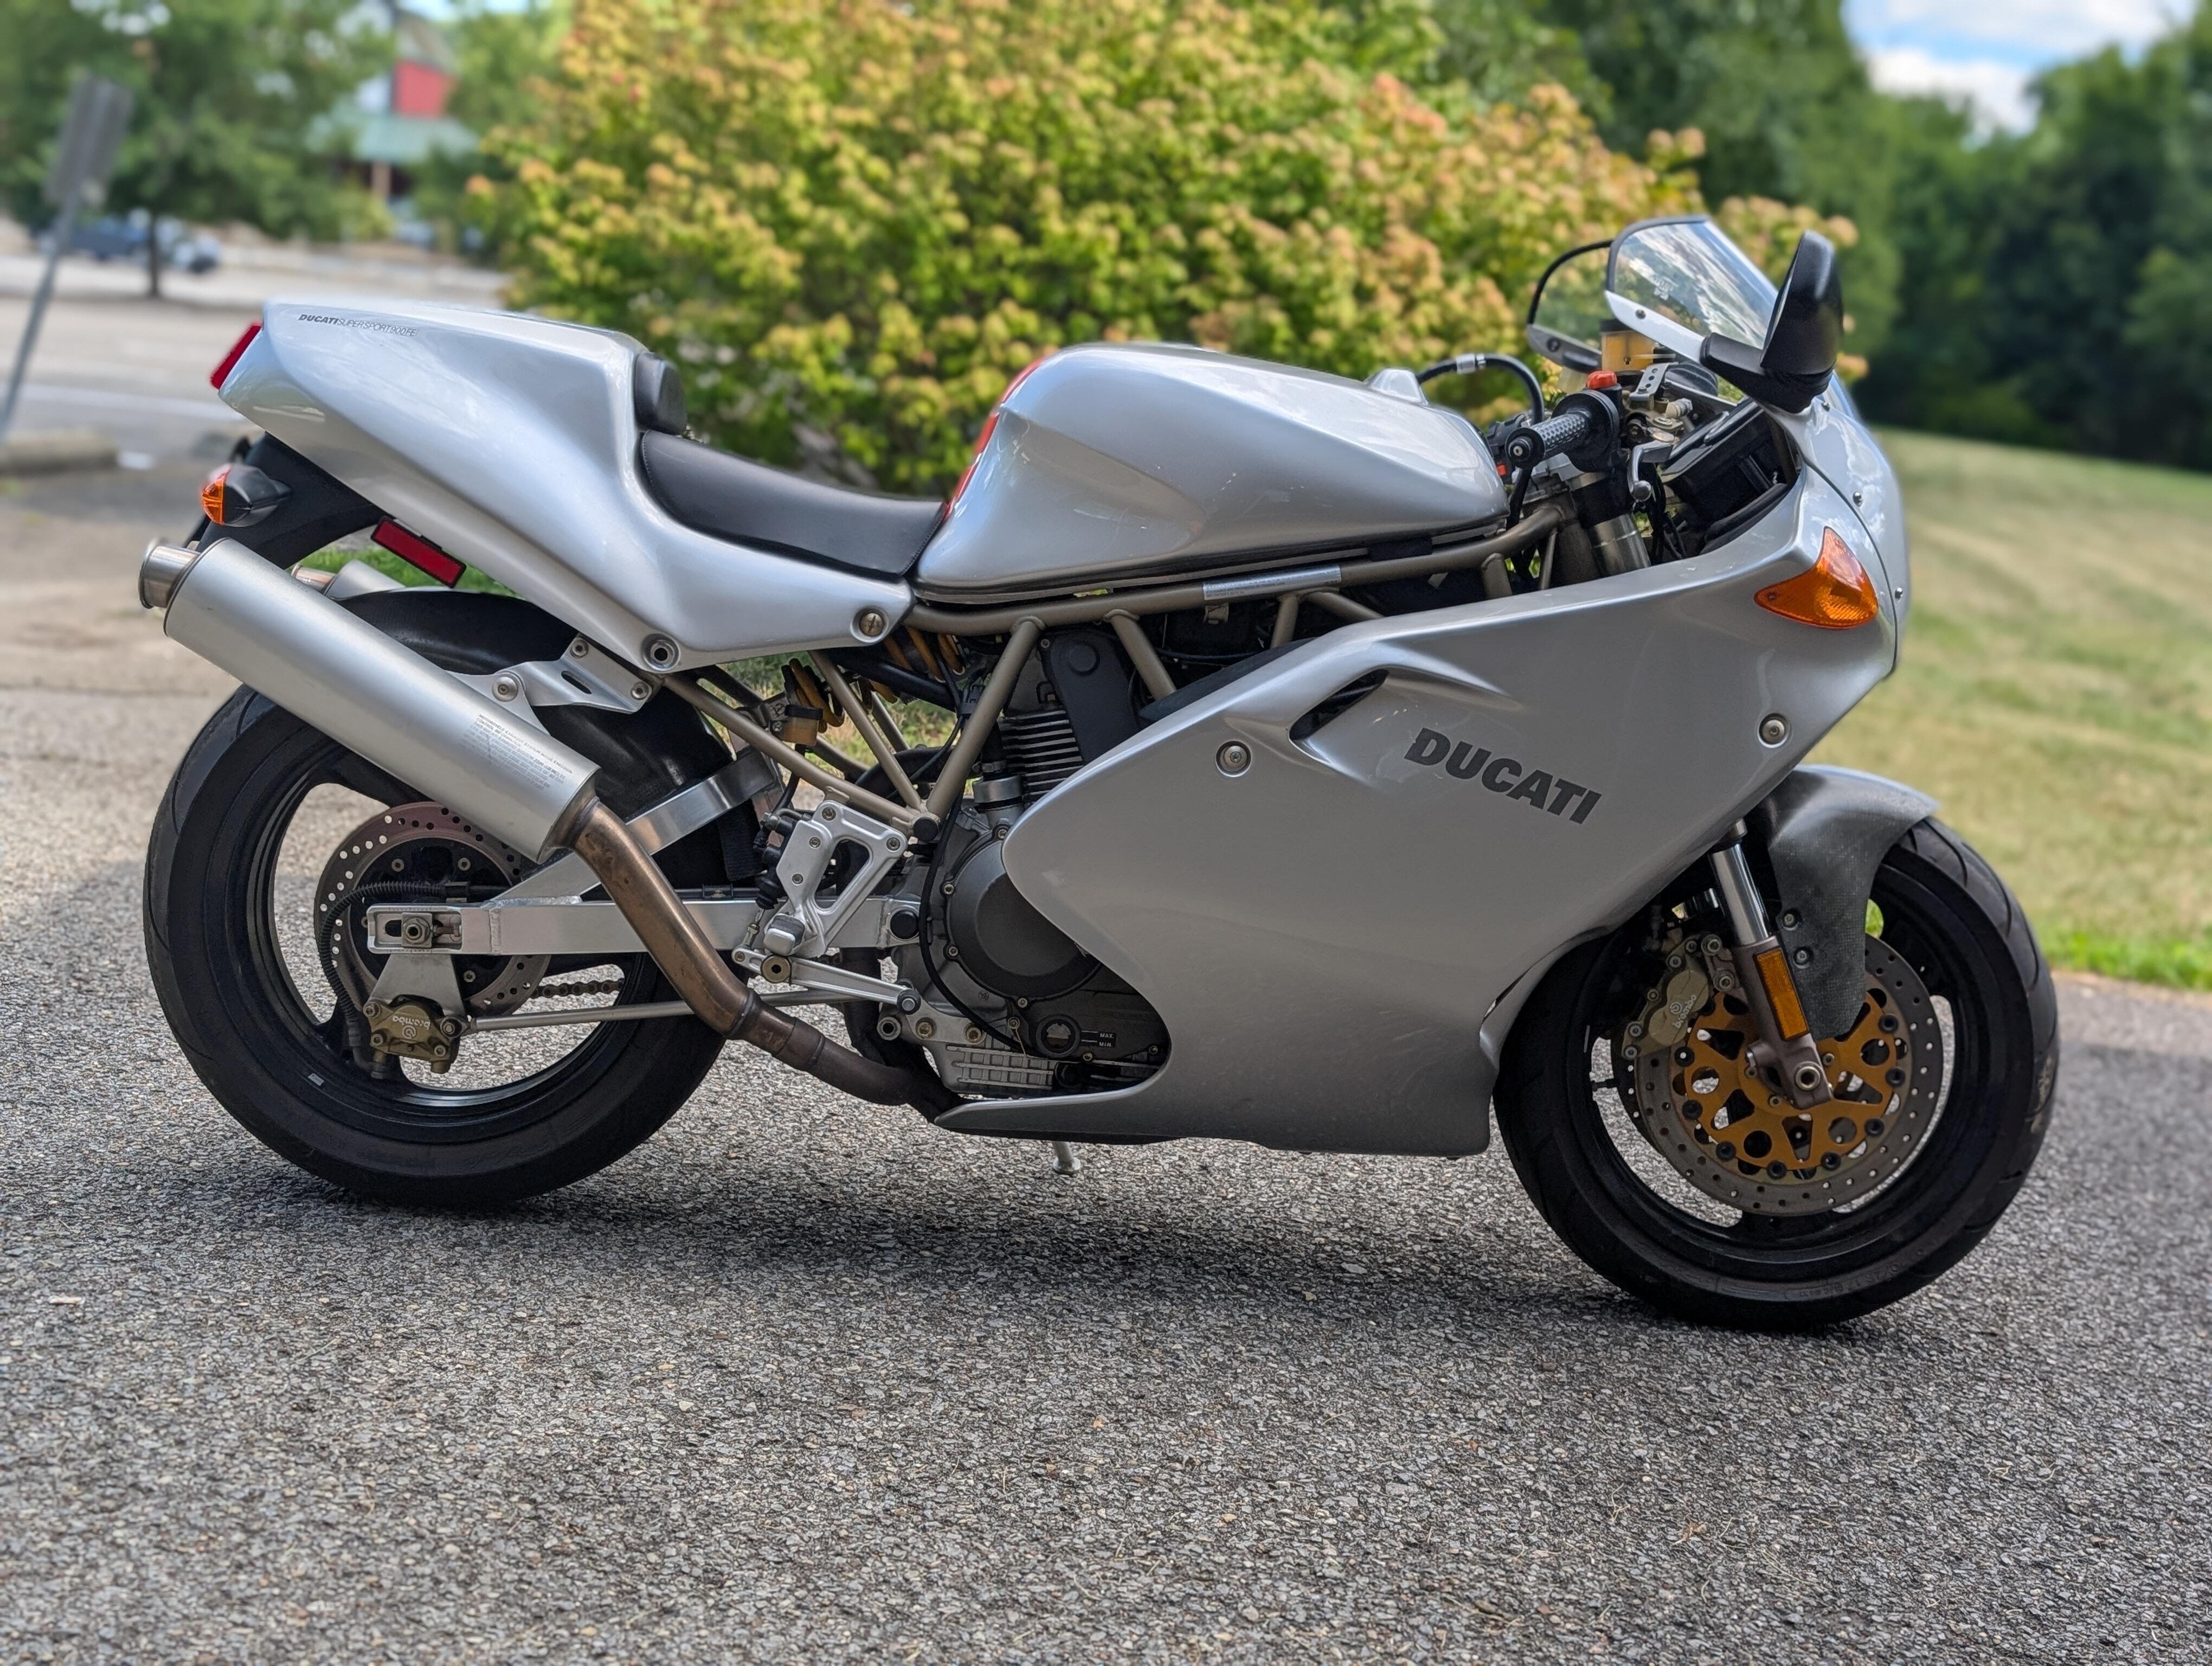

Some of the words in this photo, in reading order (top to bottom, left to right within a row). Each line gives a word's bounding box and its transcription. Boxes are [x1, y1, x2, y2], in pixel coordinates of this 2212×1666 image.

[1404, 727, 1602, 824] DUCATI
[393, 1015, 430, 1030] brembo
[1673, 995, 1696, 1029] brembo
